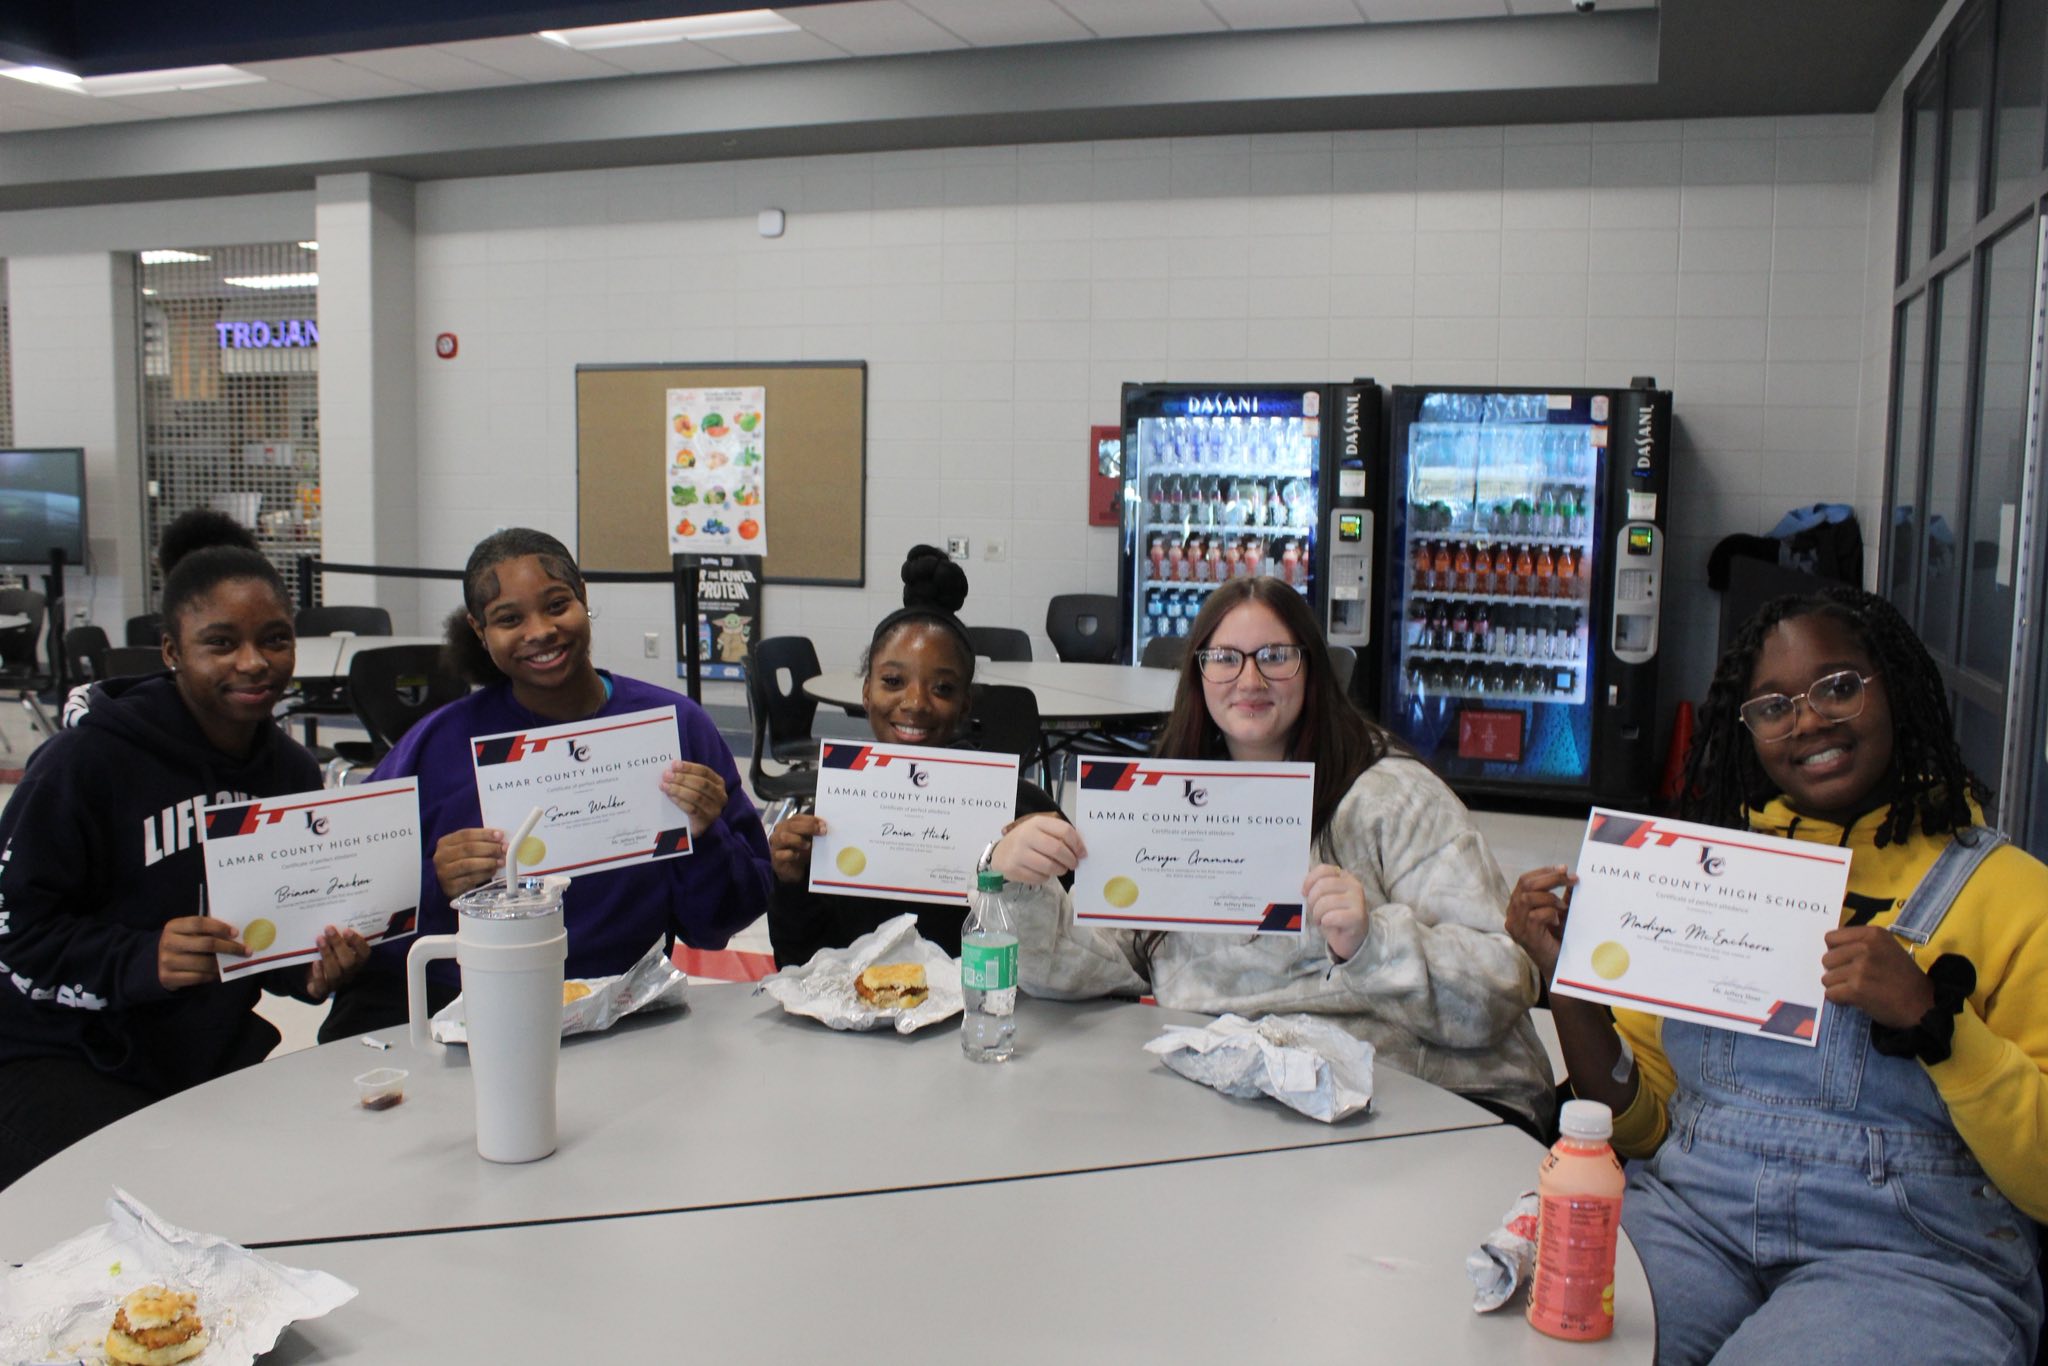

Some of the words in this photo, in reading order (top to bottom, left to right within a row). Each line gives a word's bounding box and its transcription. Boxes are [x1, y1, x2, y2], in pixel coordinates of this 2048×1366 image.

[215, 319, 319, 350] TROJAN
[1187, 394, 1259, 415] DASANI
[1345, 393, 1361, 456] DASANI
[1635, 405, 1655, 469] DASANI
[720, 570, 755, 582] POWER
[698, 582, 749, 599] PROTEIN
[489, 778, 530, 792] LAMAR
[536, 769, 585, 784] COUNTY
[592, 763, 621, 774] HIGH
[627, 753, 674, 768] SCHOOL
[588, 794, 625, 813] Walker
[828, 787, 866, 797] LAMAR
[873, 791, 920, 802] COUNTY
[926, 795, 955, 804] HIGH
[961, 798, 1007, 809] SCHOOL
[1089, 811, 1135, 821] LAMAR
[1142, 813, 1198, 823] COUNTY
[1206, 815, 1240, 824] HIGH
[1248, 816, 1302, 826] SCHOOL
[218, 853, 264, 868] LAMAR
[270, 843, 323, 859] COUNTY
[329, 837, 360, 849] HIGH
[366, 827, 413, 843] SCHOOL
[326, 874, 372, 894] Jackson
[1591, 864, 1641, 881] LAMAR
[1648, 873, 1711, 894] COUNTY
[1718, 886, 1758, 902] HIGH
[1765, 894, 1831, 915] SCHOOL
